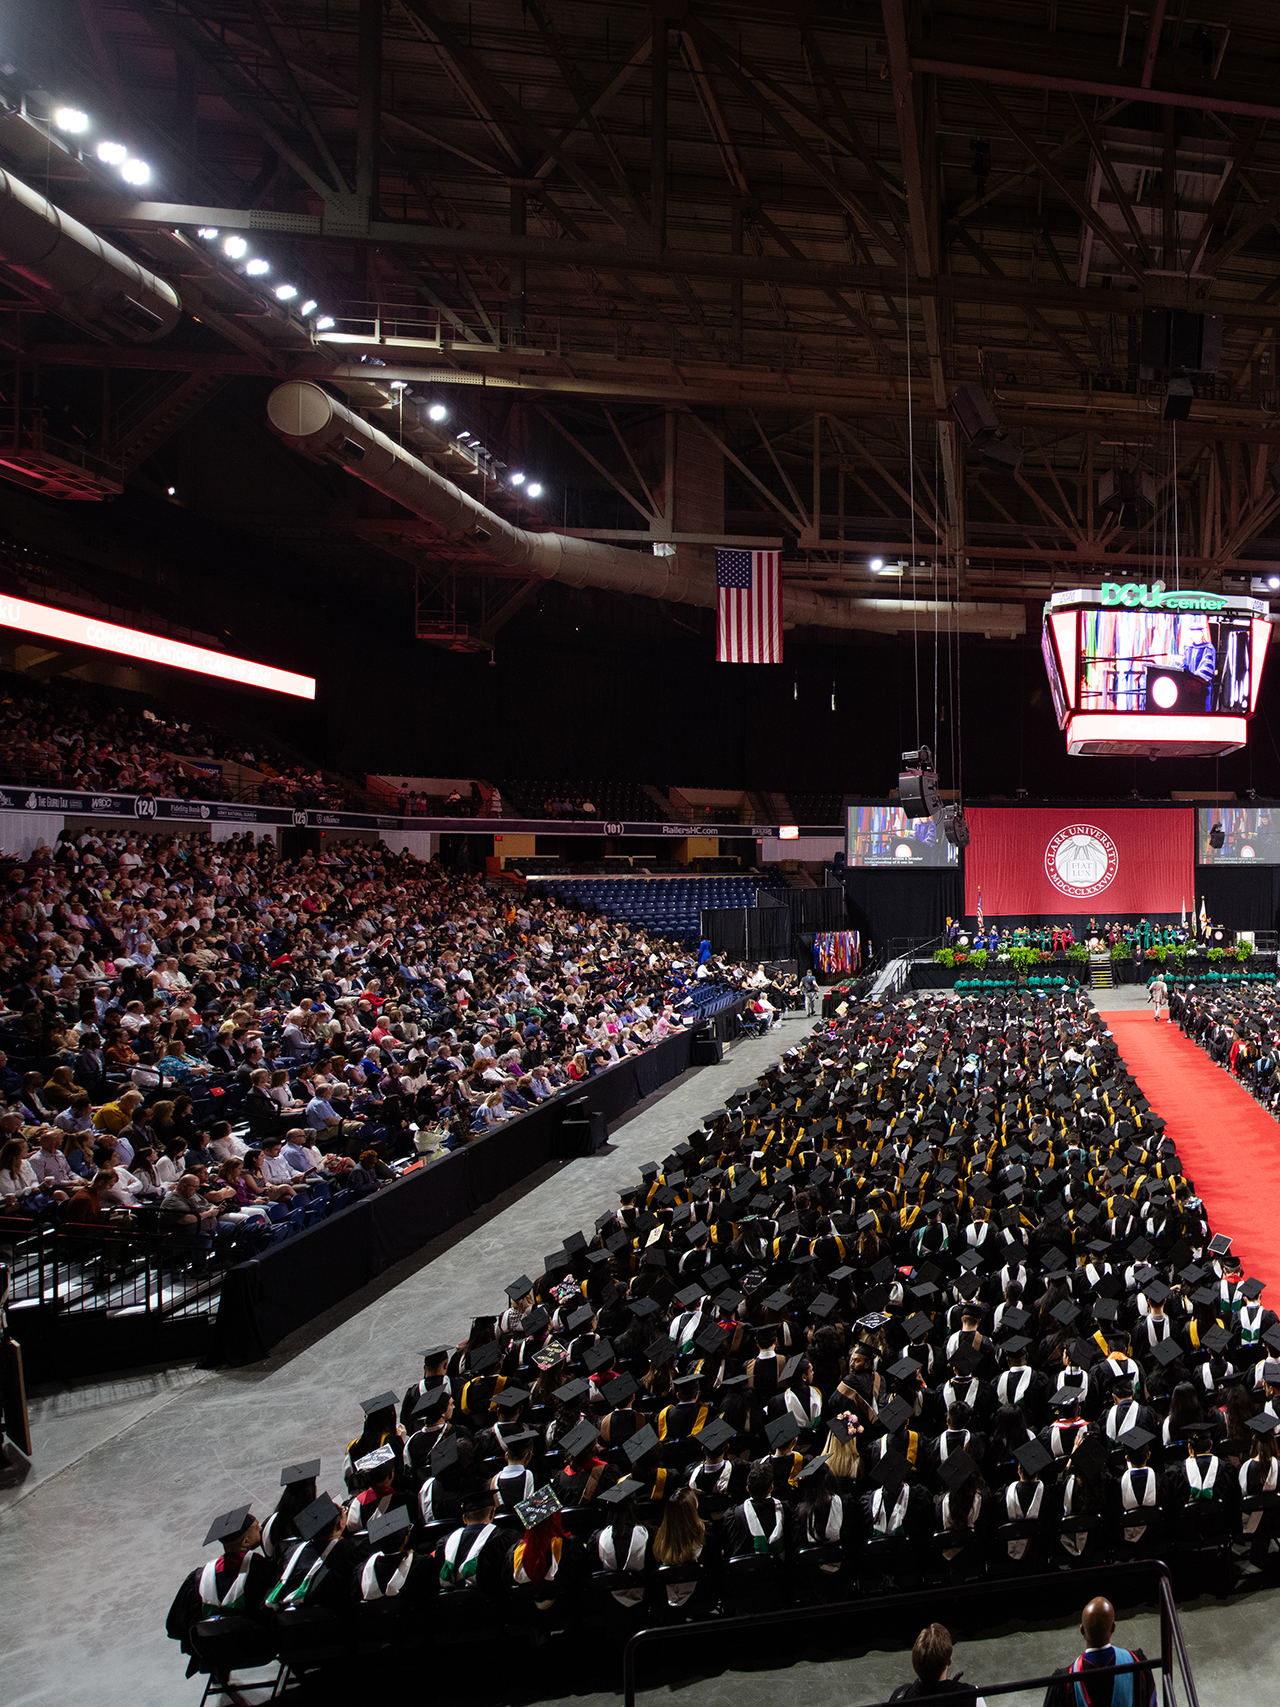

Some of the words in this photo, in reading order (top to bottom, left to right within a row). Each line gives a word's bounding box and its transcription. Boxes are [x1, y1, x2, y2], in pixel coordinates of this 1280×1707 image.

[1102, 583, 1163, 608] DCU
[1166, 597, 1225, 610] center
[86, 625, 200, 668] CONGRATULATIONS,
[202, 655, 231, 675] CLASS
[233, 664, 245, 678] OF
[247, 667, 270, 684] 2024!
[1117, 720, 1211, 735] #ClarkU2024
[137, 800, 155, 816] 124
[170, 804, 188, 814] Fidelity
[188, 805, 201, 813] Bank
[294, 812, 306, 825] 125
[322, 815, 341, 824] Alliance
[606, 823, 621, 834] 101
[662, 826, 718, 835] RailersHC.com
[1047, 831, 1068, 866] CLARK
[1068, 826, 1116, 866] UNIVERSITY
[1051, 872, 1112, 896] MDCCCLXXXVII
